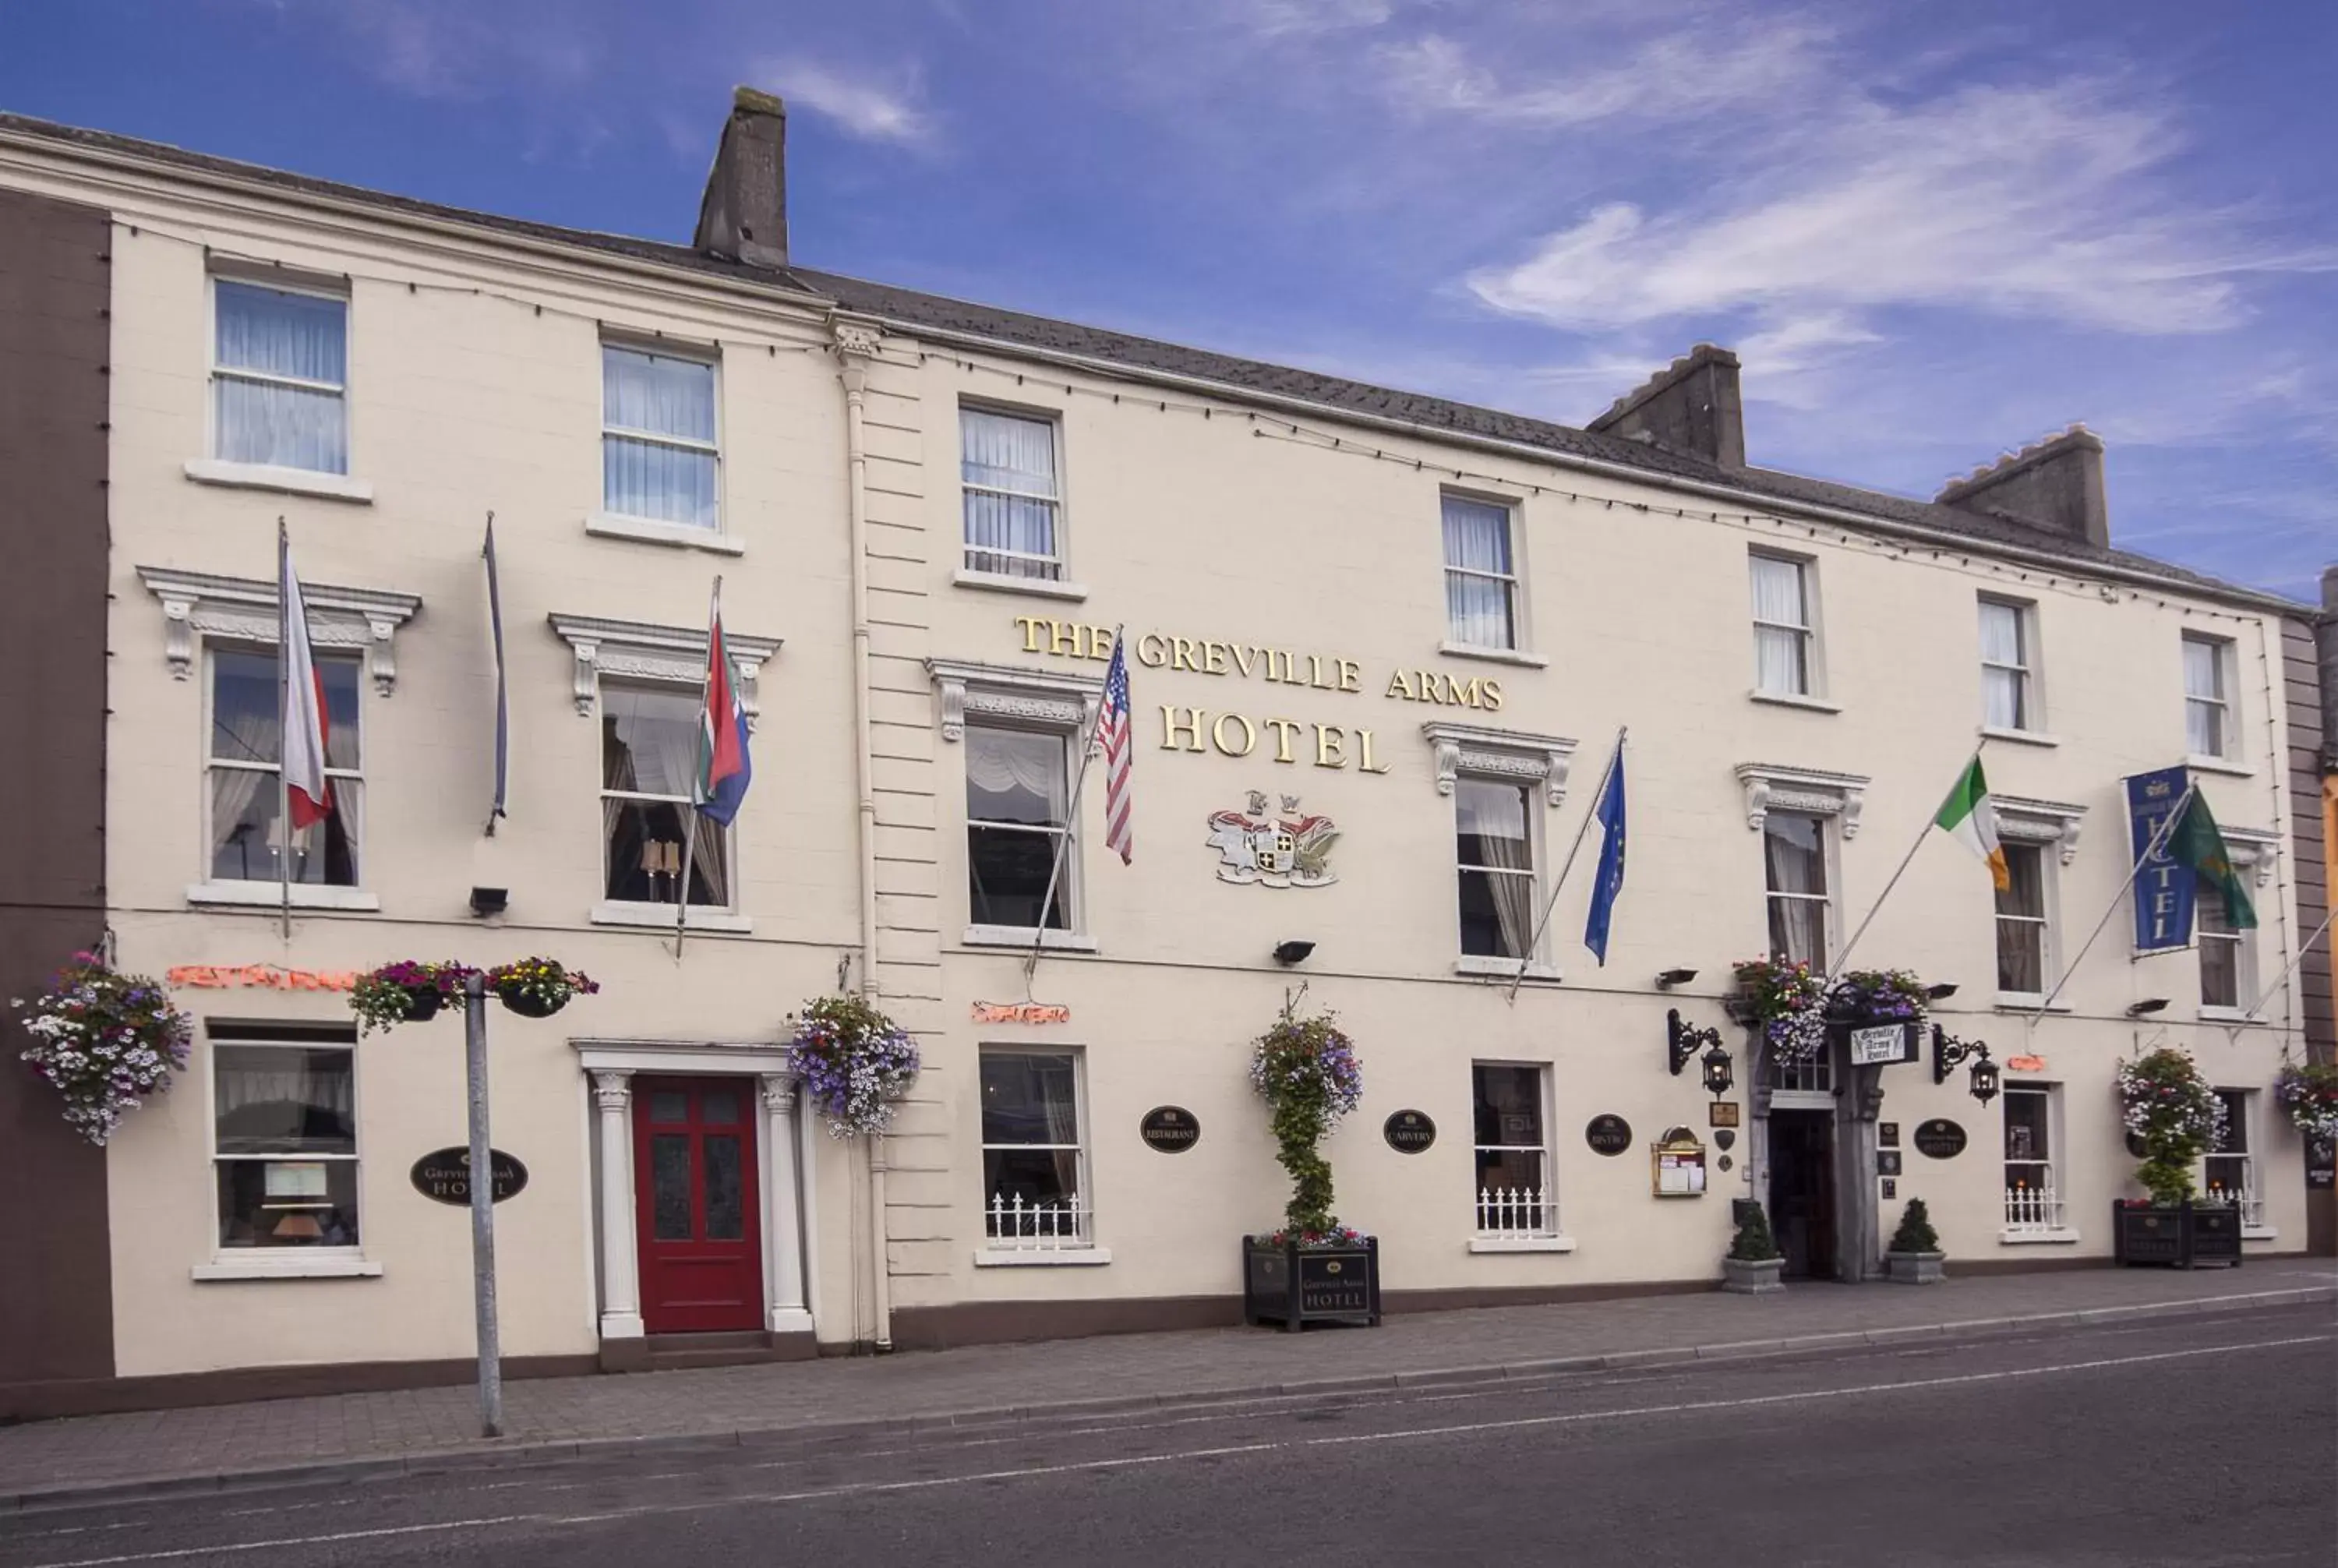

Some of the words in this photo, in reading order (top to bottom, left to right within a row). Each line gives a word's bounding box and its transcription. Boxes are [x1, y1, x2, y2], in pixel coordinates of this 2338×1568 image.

[1015, 616, 1114, 662] THE
[1136, 634, 1364, 693] GREVILLE
[1385, 668, 1503, 711] ARMS
[1159, 704, 1394, 775] HOTEL
